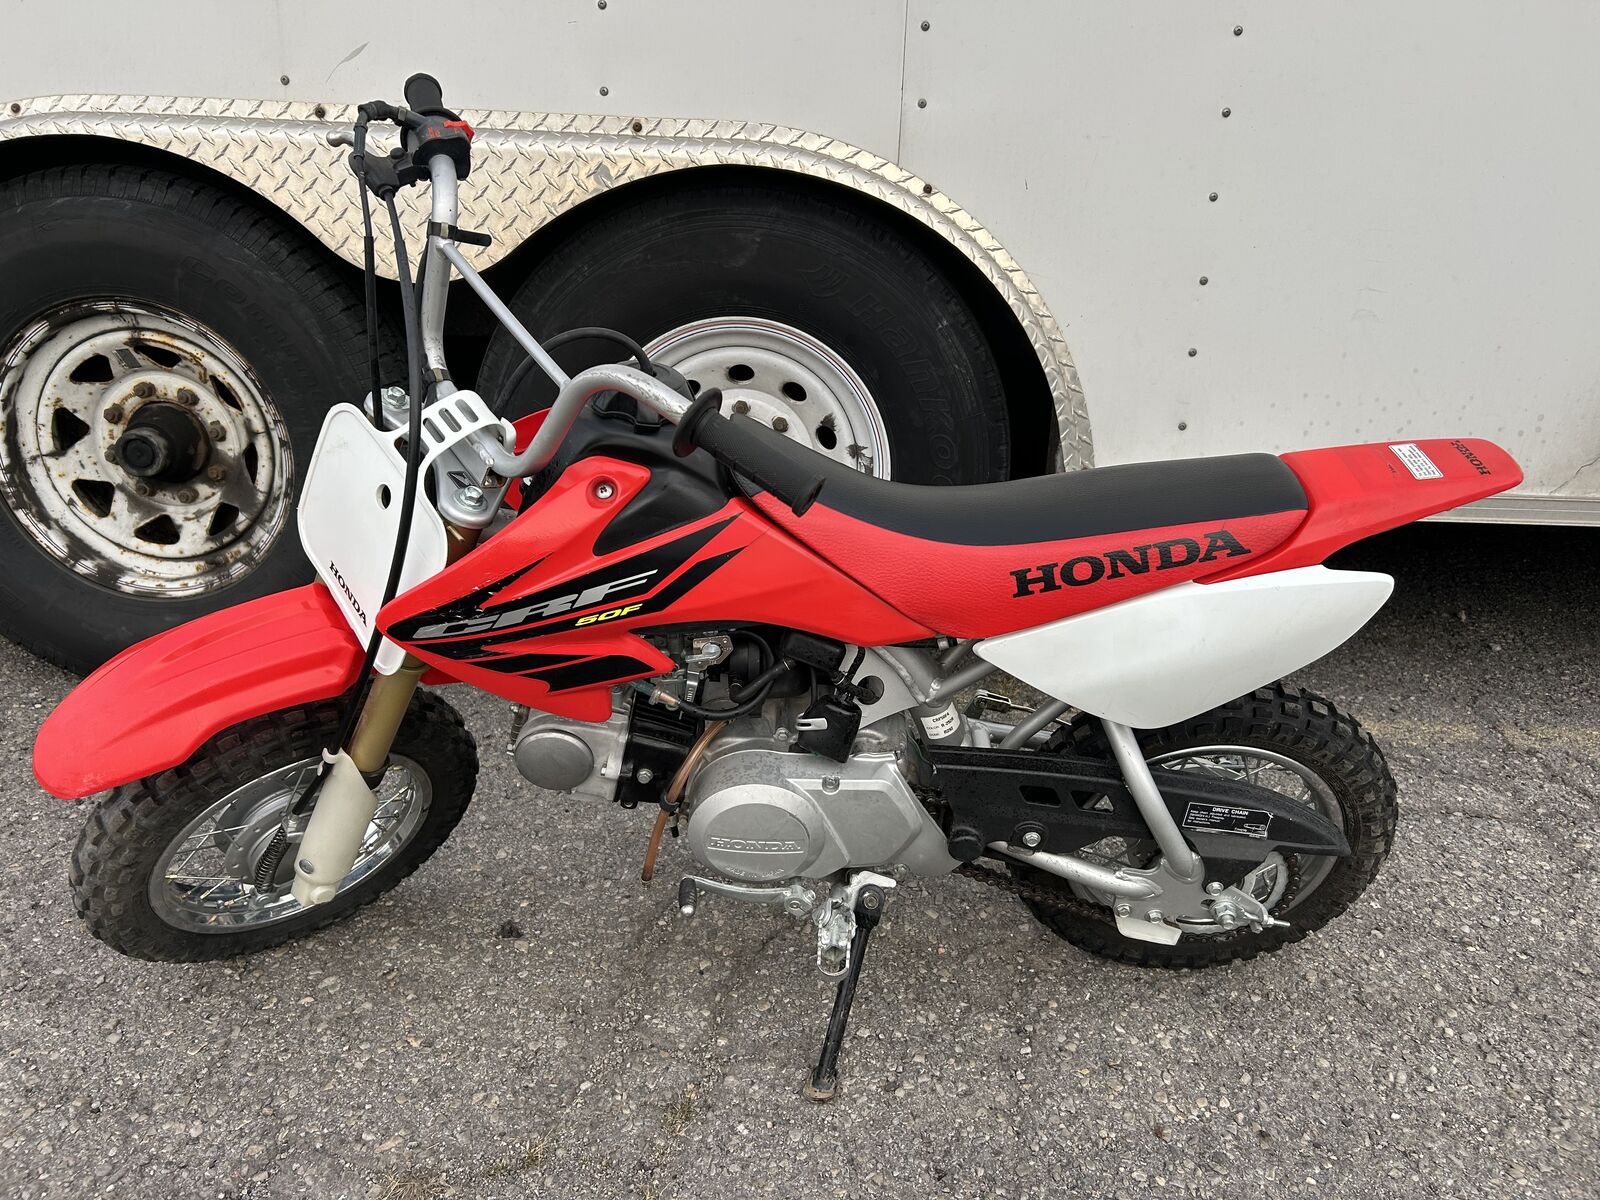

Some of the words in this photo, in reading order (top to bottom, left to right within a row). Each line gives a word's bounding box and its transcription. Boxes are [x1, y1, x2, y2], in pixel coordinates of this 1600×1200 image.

[1450, 440, 1491, 475] HONDA
[1009, 529, 1252, 599] HONDA
[329, 560, 368, 628] HONDA
[412, 569, 659, 639] CRF
[574, 603, 634, 627] 50F
[709, 837, 802, 850] HONDA
